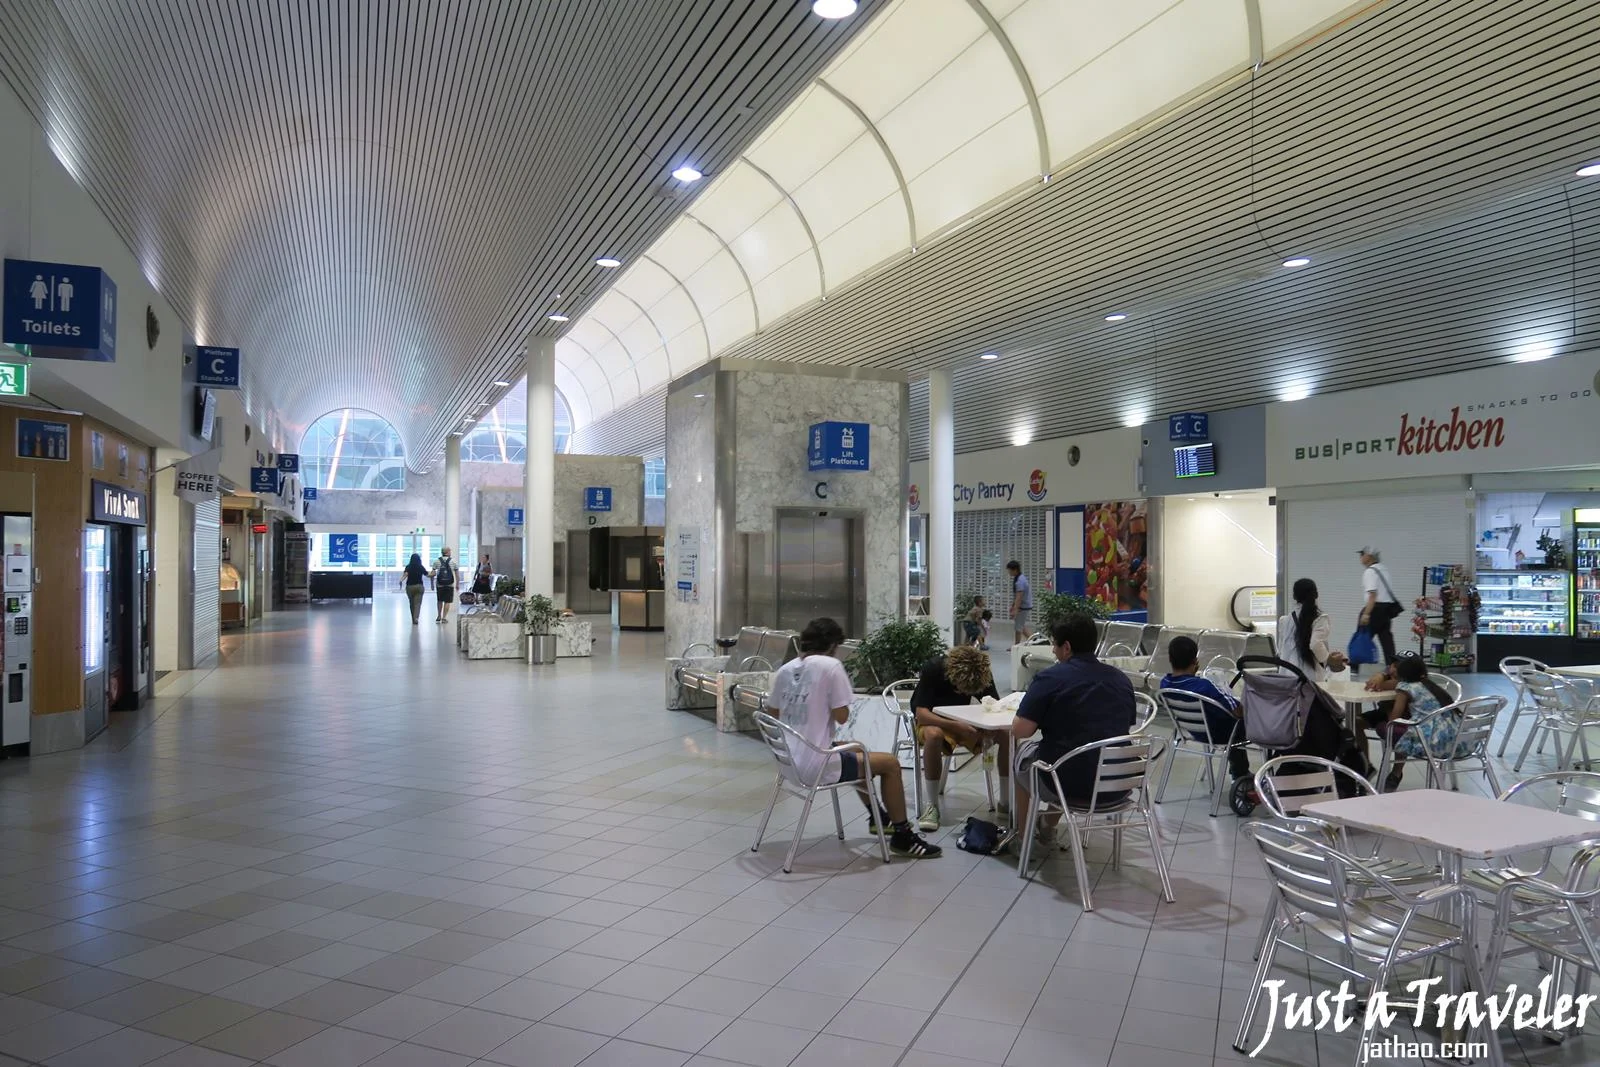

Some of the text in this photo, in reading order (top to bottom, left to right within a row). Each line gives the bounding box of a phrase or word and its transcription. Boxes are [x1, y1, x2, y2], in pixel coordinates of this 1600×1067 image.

[21, 319, 81, 336] Toilets
[211, 358, 225, 374] C
[1467, 389, 1592, 412] SNACKS TO GO
[1175, 421, 1182, 433] C
[1193, 420, 1202, 433] C
[1397, 406, 1505, 456] kitchen
[841, 450, 854, 458] Lift
[284, 459, 293, 468] D
[830, 457, 865, 466] Platform C
[178, 471, 215, 482] COFFEE
[177, 480, 214, 493] HERE
[815, 481, 828, 499] C
[953, 483, 976, 504] City
[977, 481, 1015, 501] Pantry
[588, 515, 597, 525] D
